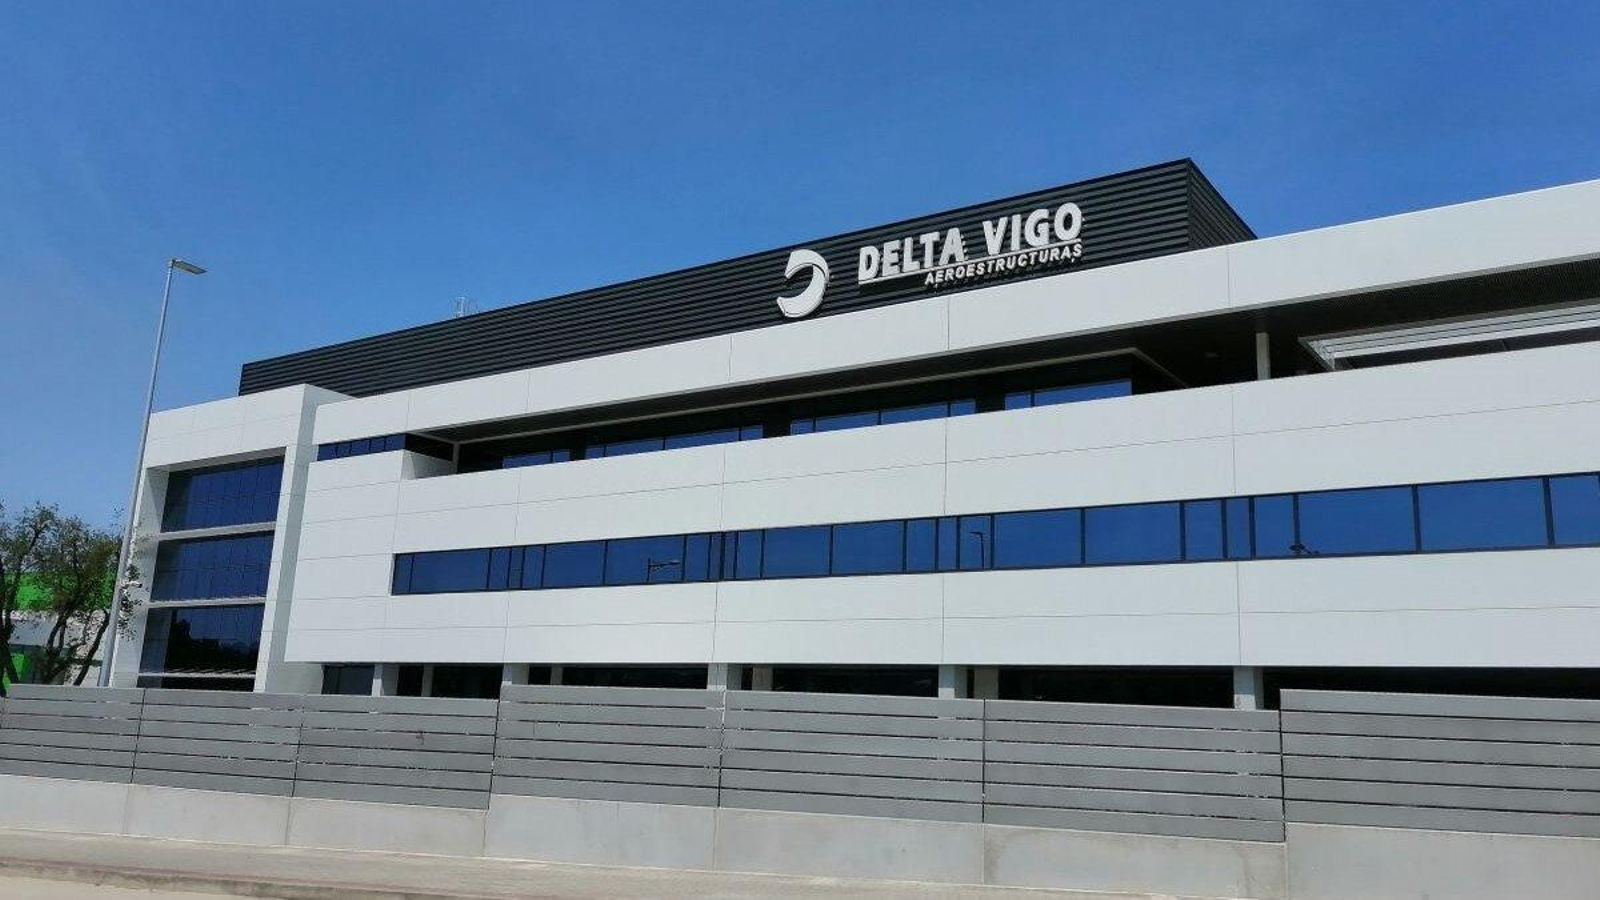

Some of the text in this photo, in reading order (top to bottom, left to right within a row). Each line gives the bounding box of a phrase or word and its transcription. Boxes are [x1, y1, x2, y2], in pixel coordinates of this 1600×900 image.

[858, 202, 1082, 282] DELTA VIGO
[924, 243, 1083, 286] AEROESTRUCTURAS
